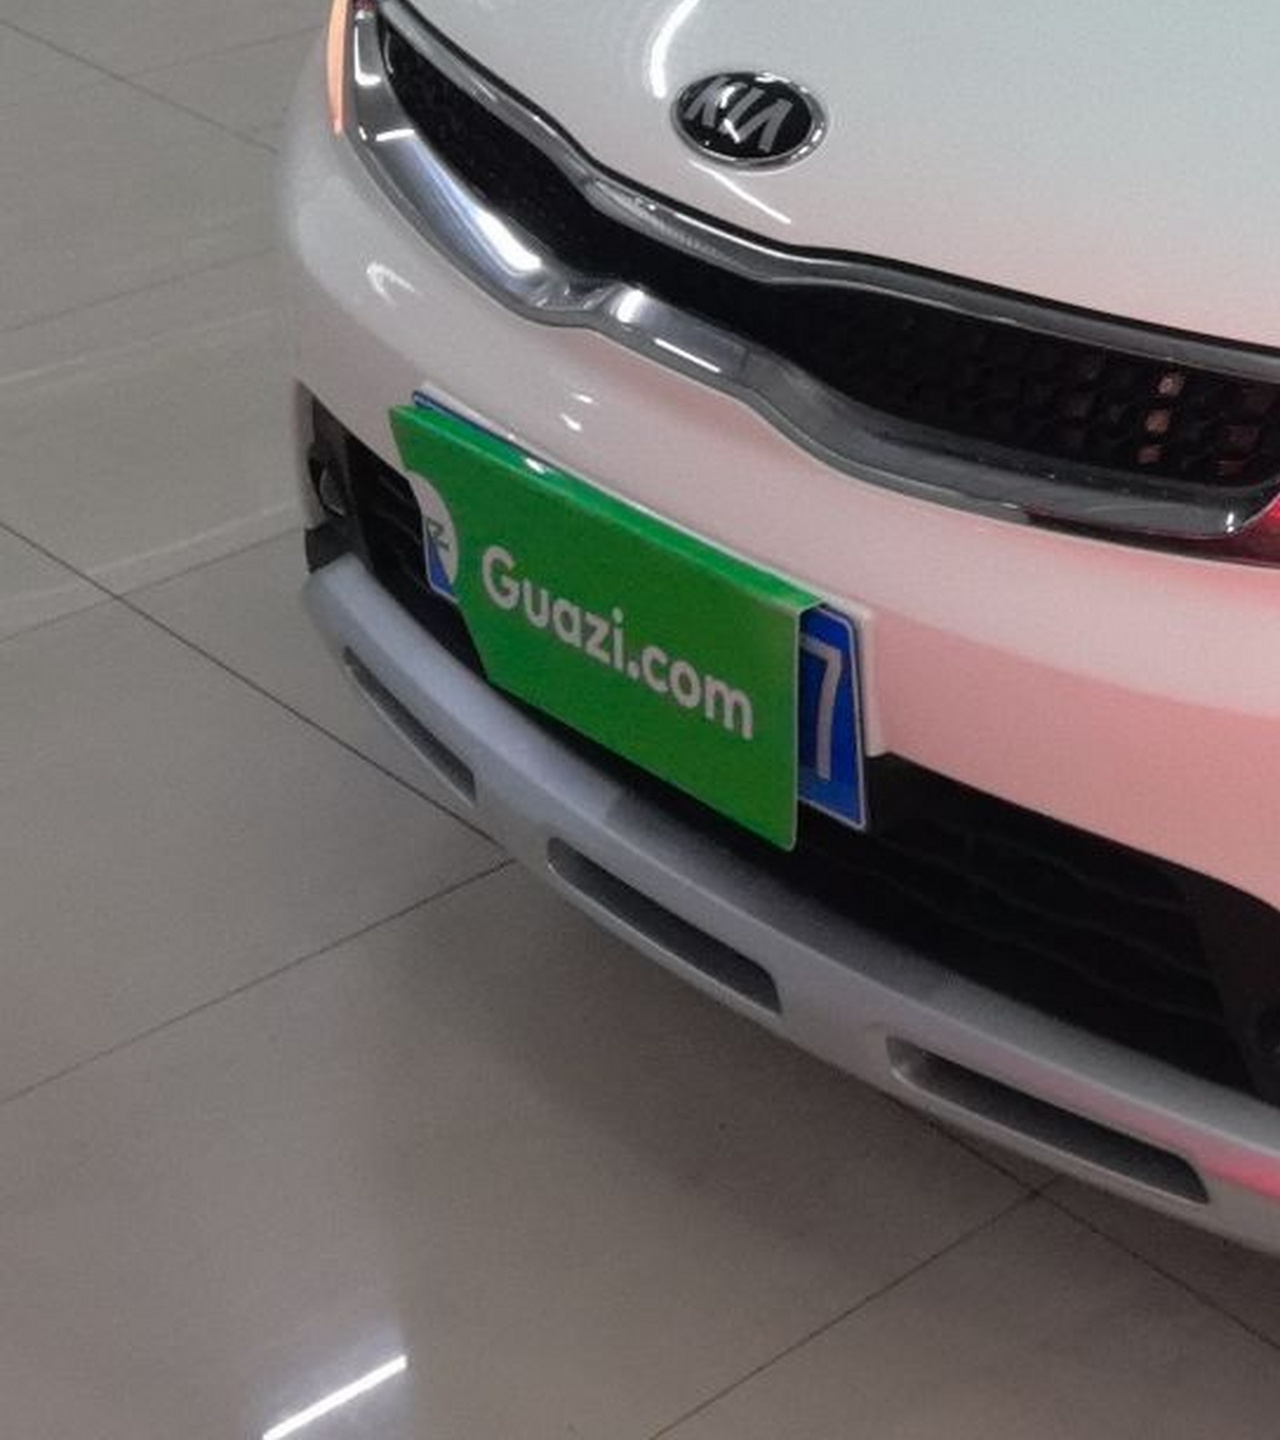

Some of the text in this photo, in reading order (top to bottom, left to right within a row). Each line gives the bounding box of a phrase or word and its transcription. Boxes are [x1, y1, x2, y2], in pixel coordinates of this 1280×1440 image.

[684, 76, 792, 152] KIA
[482, 546, 754, 741] Guazi.com
[804, 641, 841, 780] 7
